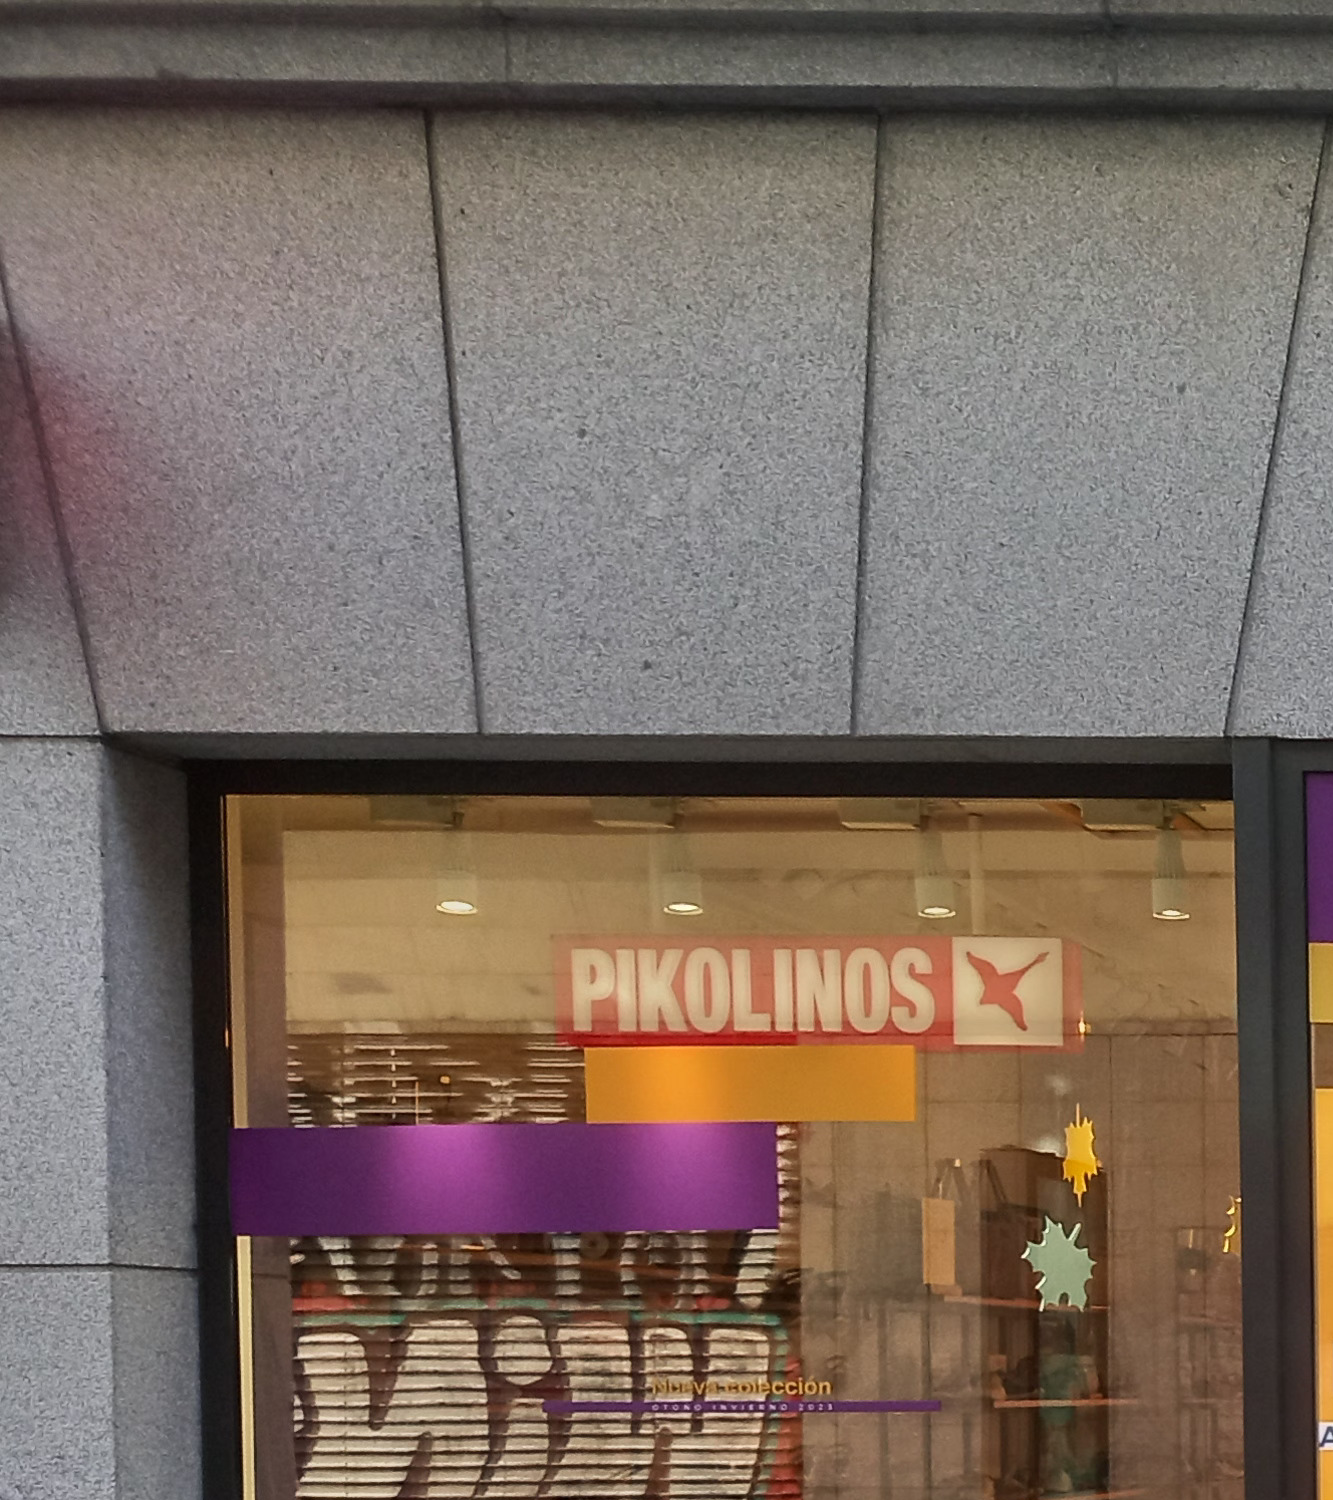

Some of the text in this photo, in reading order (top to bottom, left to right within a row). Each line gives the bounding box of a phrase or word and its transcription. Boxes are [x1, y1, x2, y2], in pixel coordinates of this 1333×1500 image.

[571, 946, 935, 1034] PIKOLINOS
[724, 1376, 832, 1395] colección
[712, 1403, 788, 1411] INVIERNO
